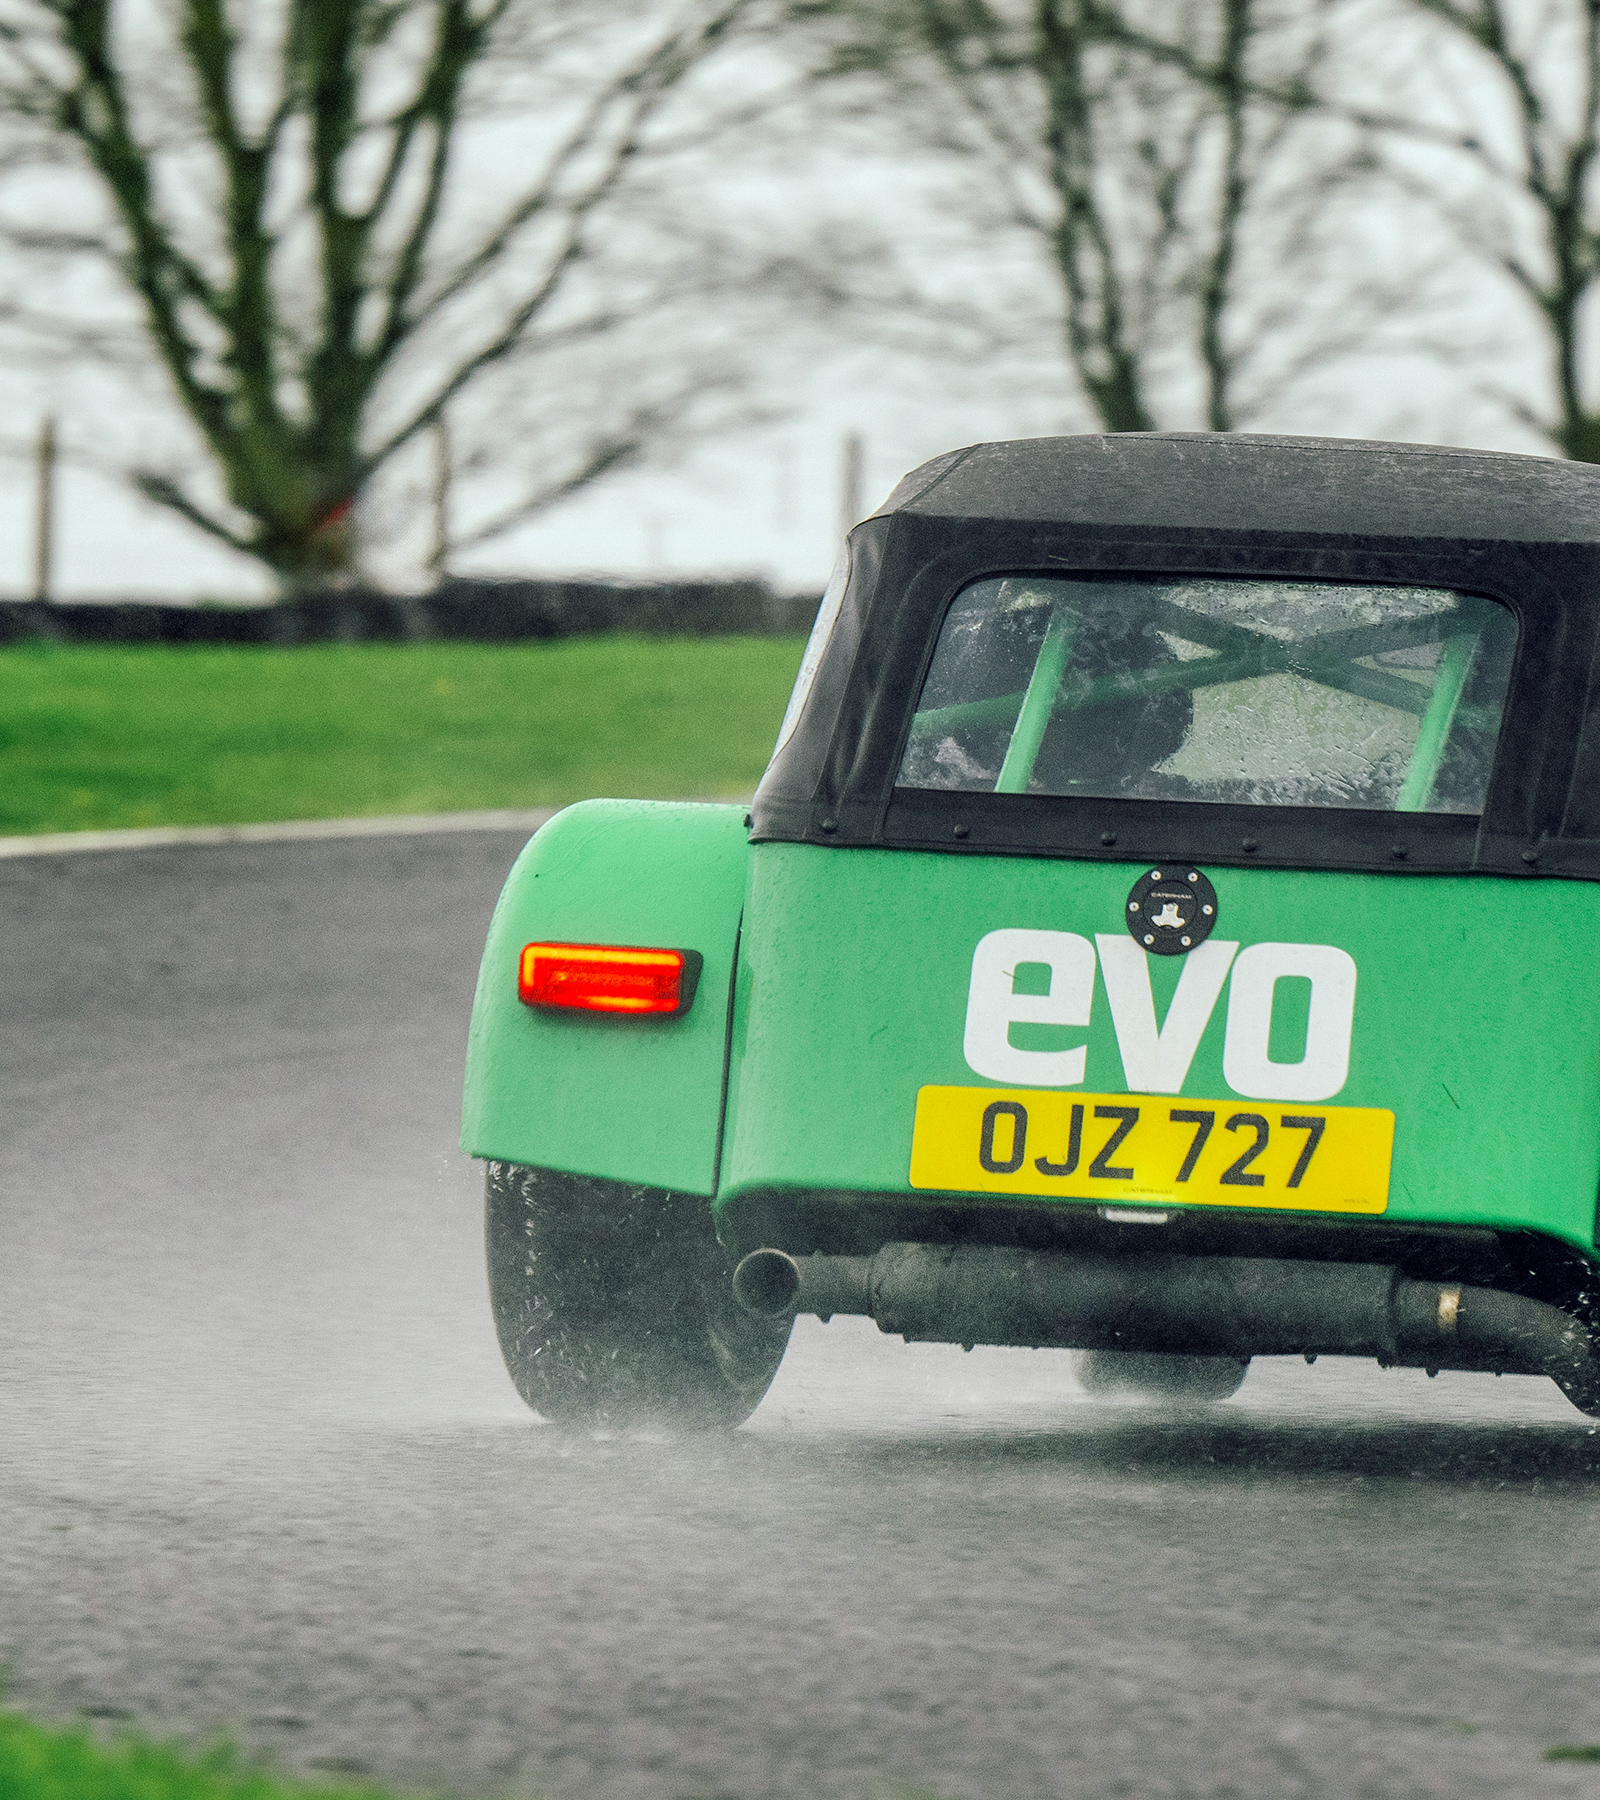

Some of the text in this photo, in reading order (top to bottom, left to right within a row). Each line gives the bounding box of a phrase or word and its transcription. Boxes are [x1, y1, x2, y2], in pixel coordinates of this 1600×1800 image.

[963, 928, 1357, 1101] evo
[978, 1101, 1326, 1188] OJZ 727
